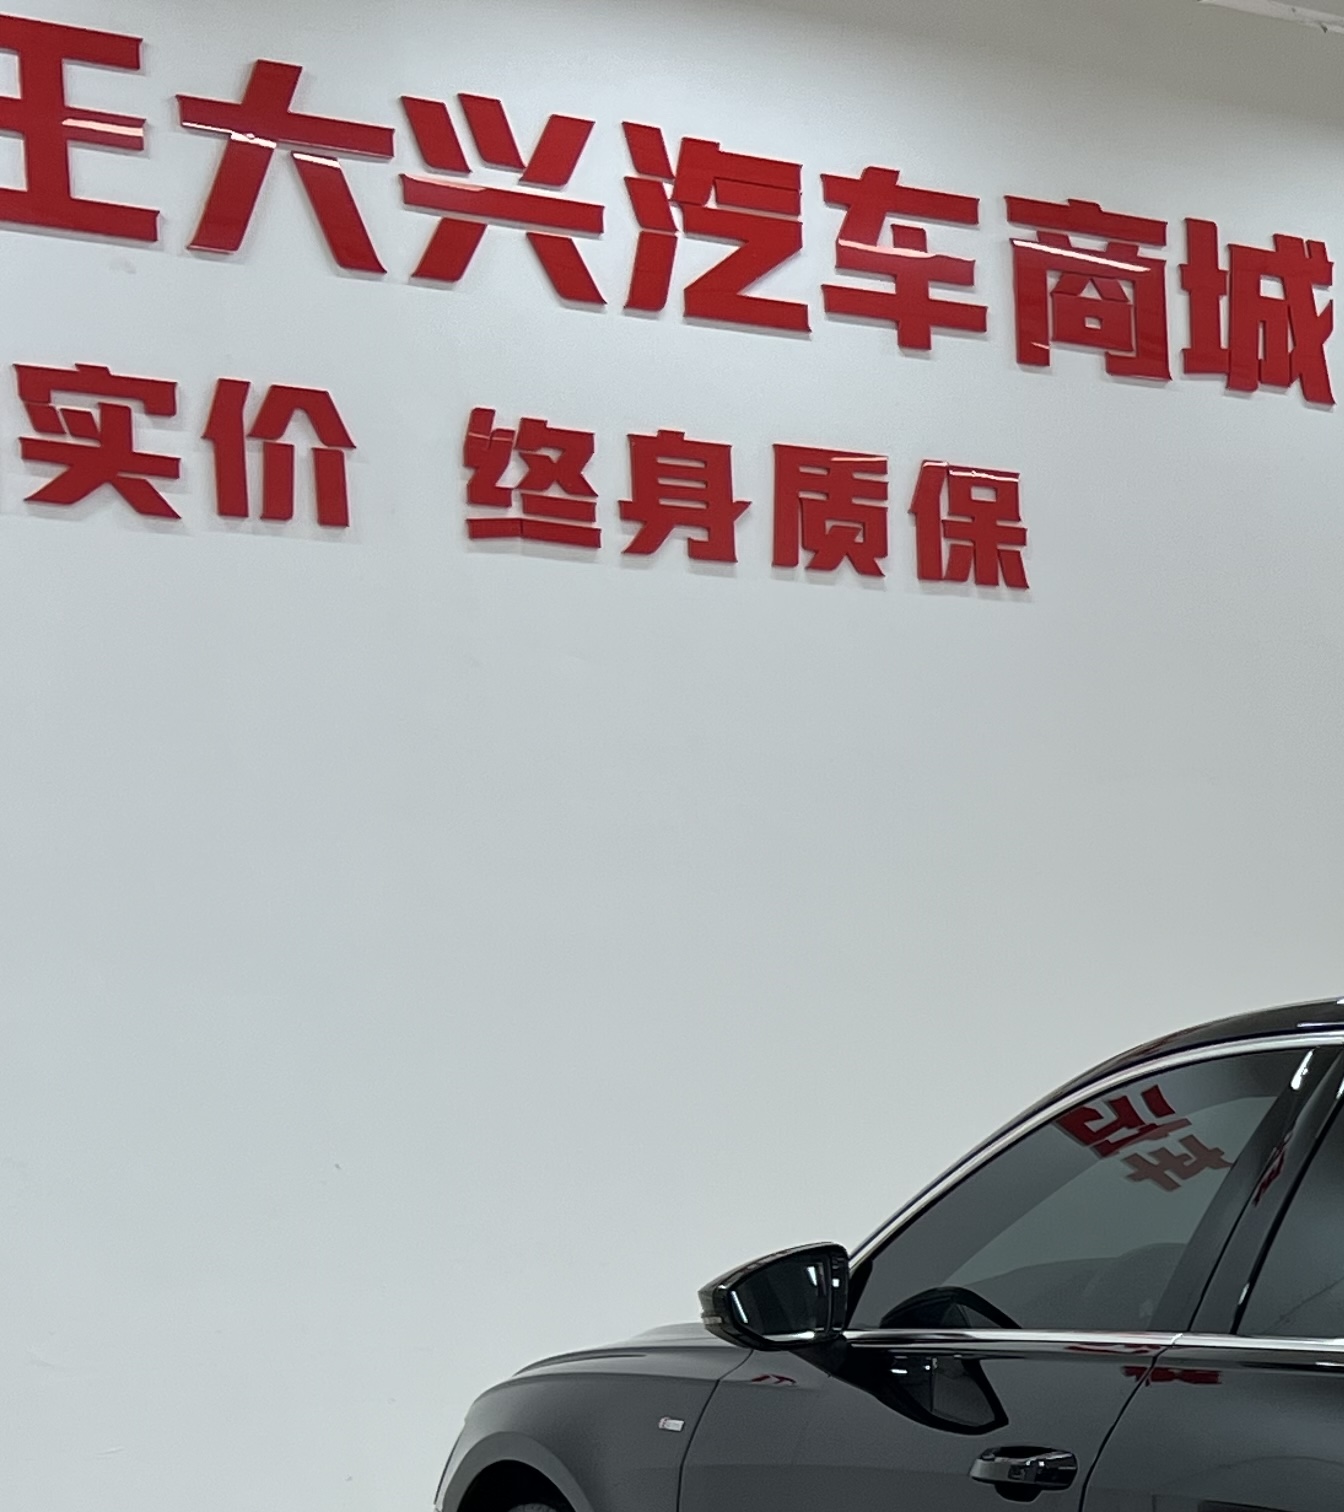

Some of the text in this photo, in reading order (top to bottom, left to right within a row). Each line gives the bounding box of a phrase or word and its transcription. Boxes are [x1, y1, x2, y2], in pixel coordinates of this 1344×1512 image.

[13, 364, 1029, 588] 实价 终身质保
